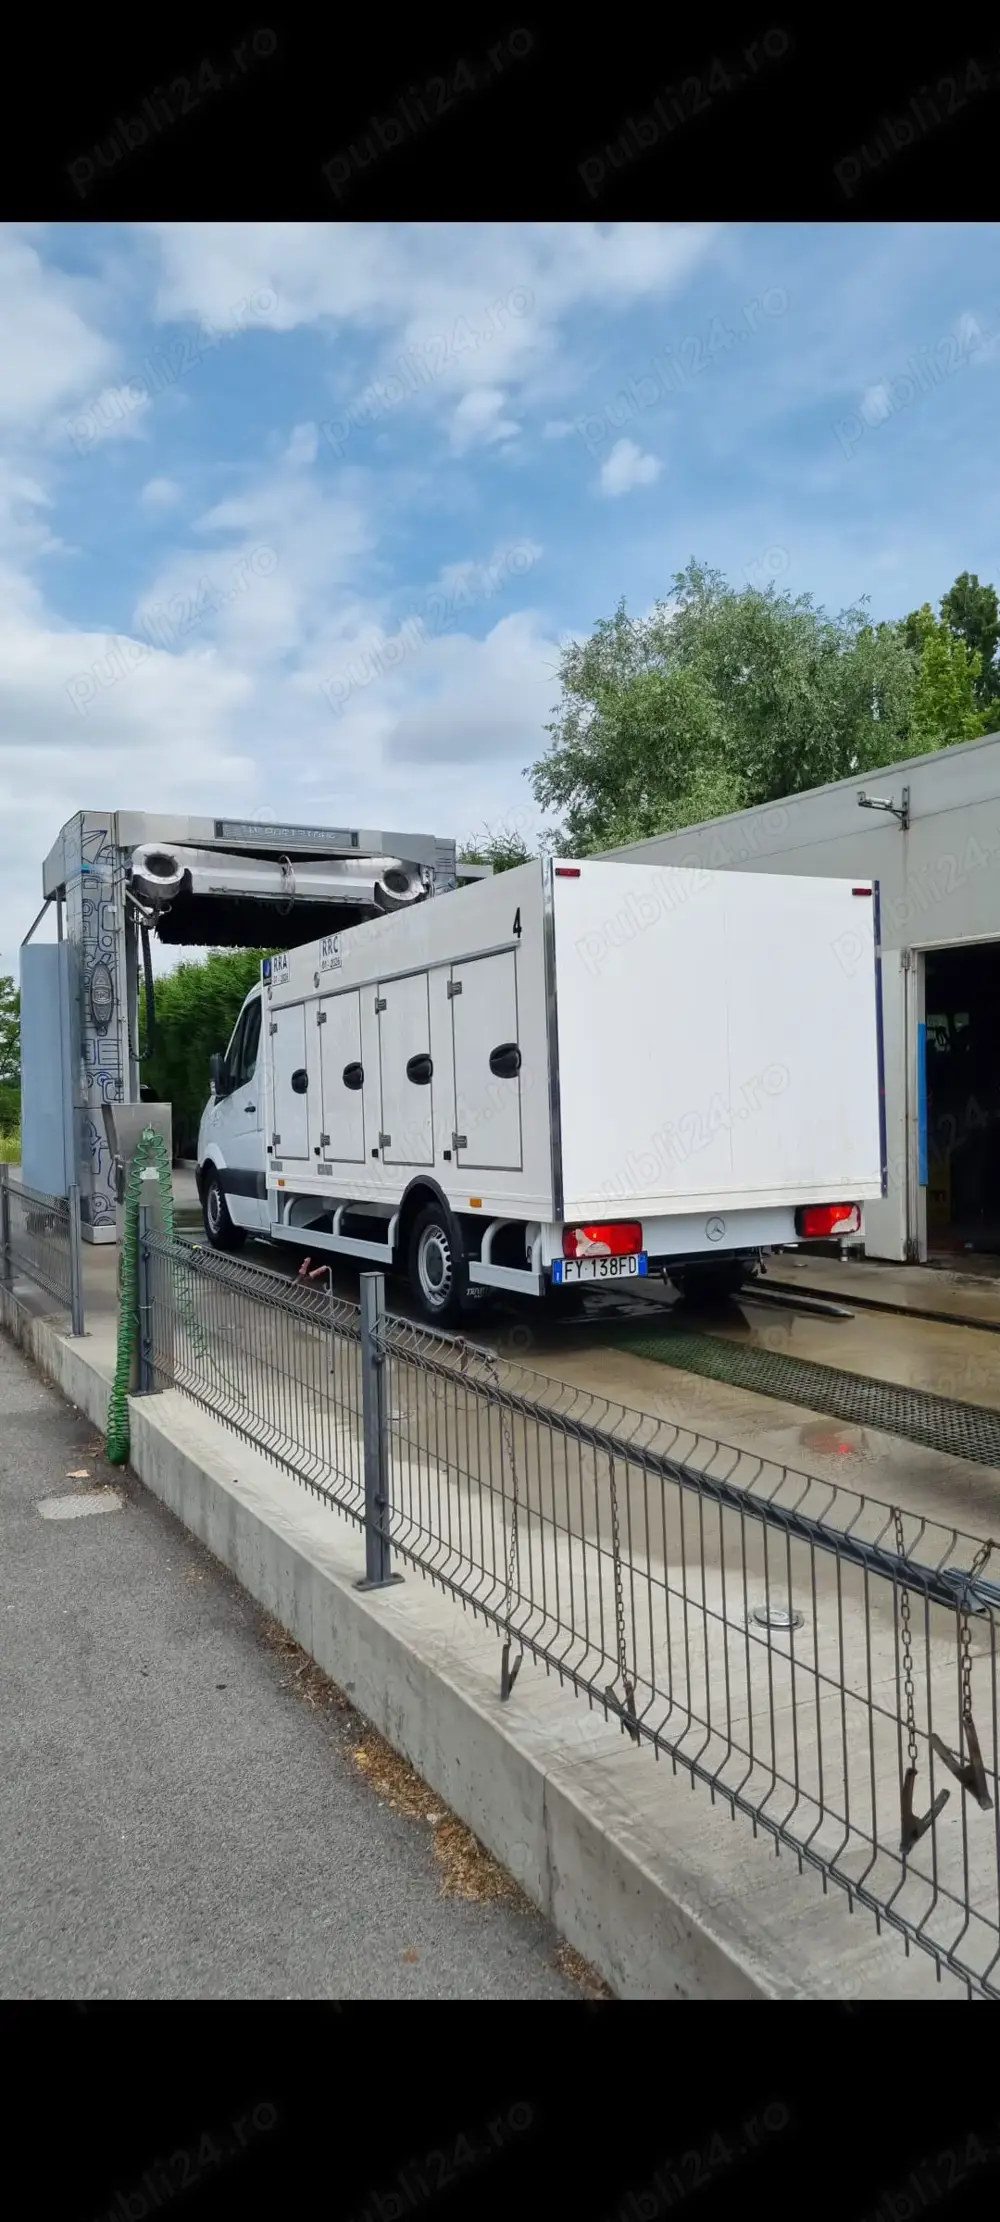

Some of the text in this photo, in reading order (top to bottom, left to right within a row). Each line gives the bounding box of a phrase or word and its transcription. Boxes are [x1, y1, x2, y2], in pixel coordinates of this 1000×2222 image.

[513, 907, 522, 938] 4
[322, 936, 338, 957] RRC
[273, 954, 288, 973] RRA
